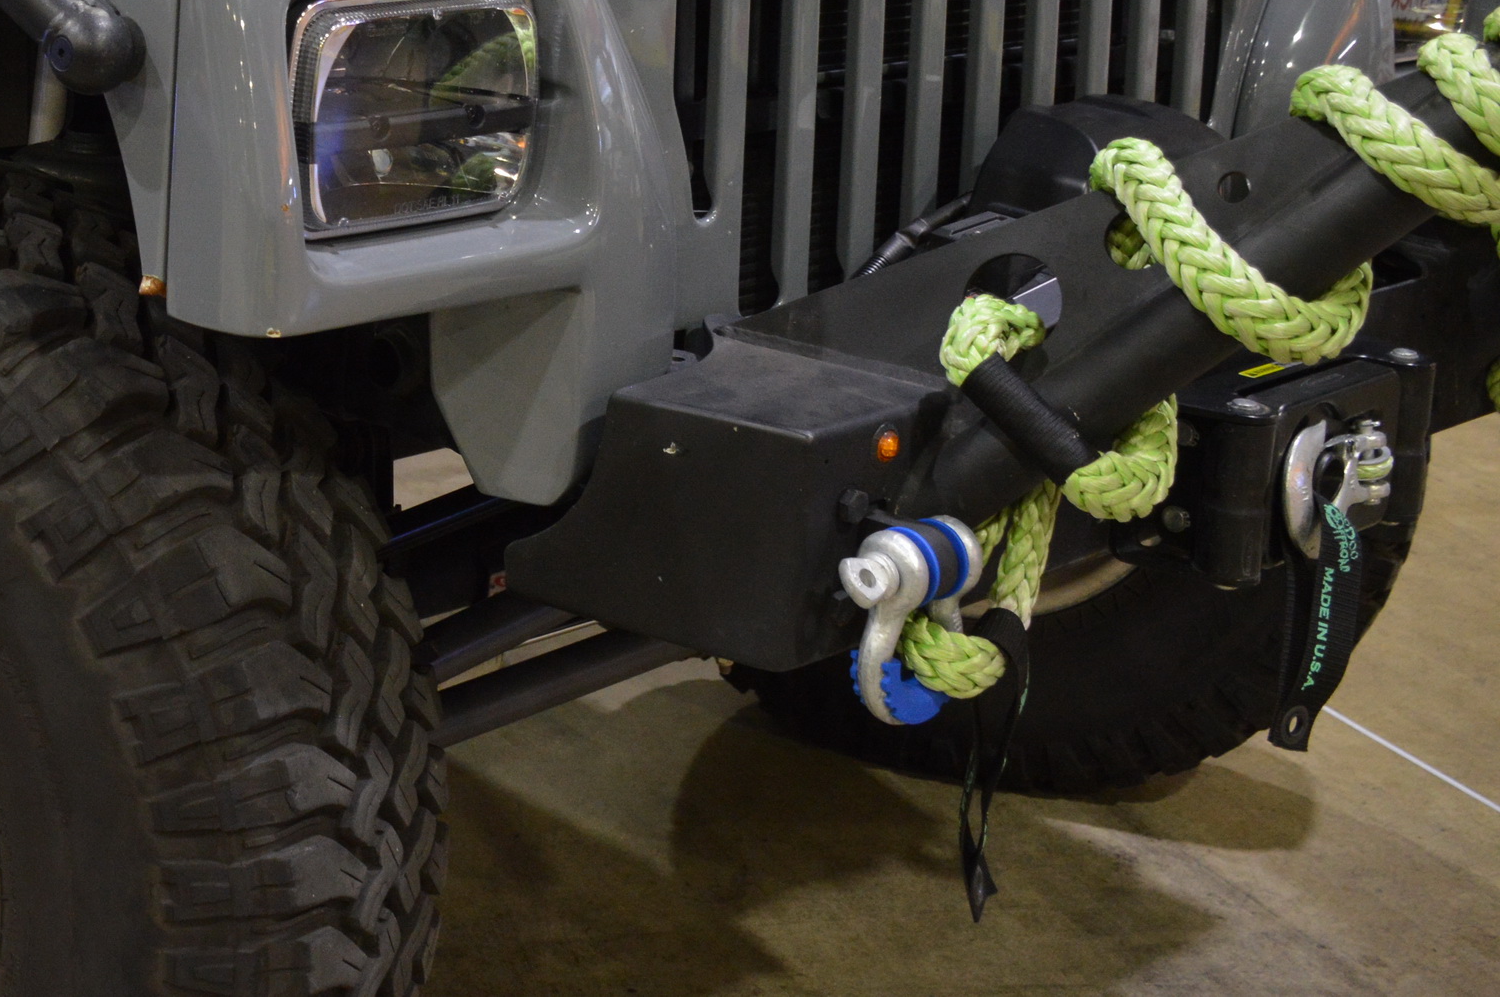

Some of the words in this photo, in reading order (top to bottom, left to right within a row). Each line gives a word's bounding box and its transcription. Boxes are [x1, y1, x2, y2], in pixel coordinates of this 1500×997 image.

[1318, 566, 1335, 620] MADE
[1316, 622, 1329, 642] IN
[1301, 644, 1327, 691] U.S.A.
